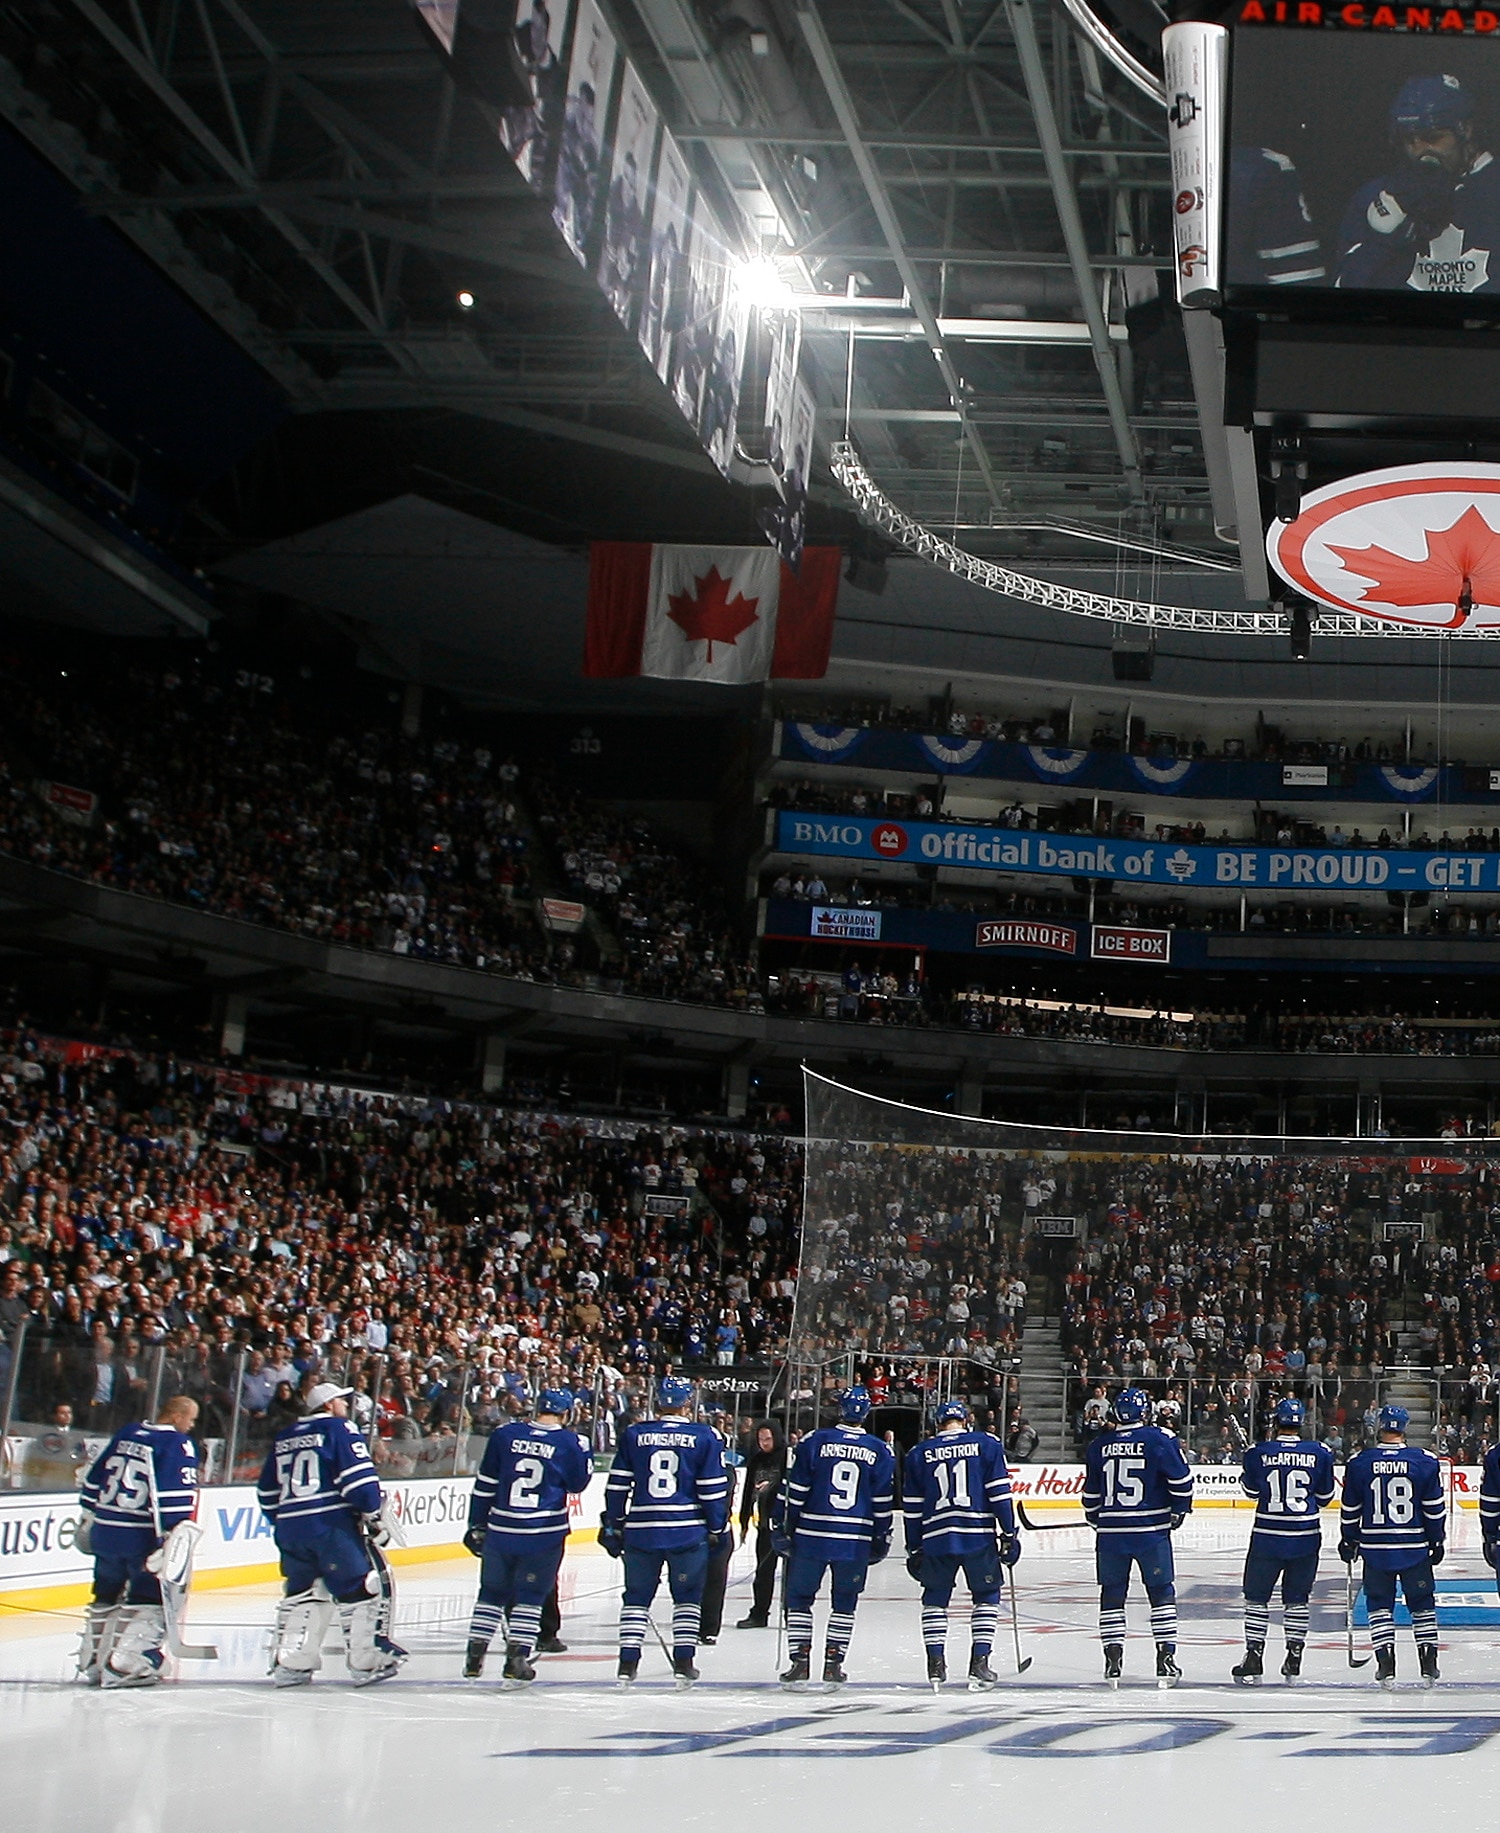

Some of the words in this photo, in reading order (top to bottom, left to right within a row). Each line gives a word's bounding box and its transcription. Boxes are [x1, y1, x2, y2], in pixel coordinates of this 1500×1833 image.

[1240, 0, 1321, 24] AIR
[1417, 260, 1476, 274] TORONTO
[1428, 272, 1466, 286] MAPLE
[793, 822, 863, 845] BMO
[920, 831, 1030, 867] Official
[1038, 838, 1116, 874] bank
[1123, 849, 1155, 876] of
[1215, 852, 1257, 883] BE
[1268, 853, 1389, 885] PROUD
[1425, 856, 1487, 887] GET
[831, 913, 876, 927] CANADIAN
[981, 924, 1071, 948] SMIRNOFF
[1099, 935, 1125, 951] ICE
[1129, 938, 1164, 955] BOX
[1039, 1220, 1070, 1233] IBM
[510, 1438, 557, 1461] SCHENN
[636, 1432, 697, 1450] KOMISAREK
[924, 1443, 979, 1463] SJOSTROM
[1101, 1442, 1144, 1458] KABERLE
[819, 1443, 877, 1466] ARMSTRONG
[1261, 1452, 1316, 1469] MacARTHUR
[276, 1449, 321, 1506] 50
[647, 1448, 680, 1499] 8
[1372, 1461, 1408, 1475] BROWN
[98, 1455, 151, 1511] 35
[508, 1456, 545, 1509] 2
[828, 1460, 861, 1510] 9
[933, 1458, 972, 1511] 11
[1101, 1458, 1146, 1507] 15
[1265, 1468, 1312, 1513] 16
[1369, 1476, 1415, 1524] 18
[216, 1506, 275, 1542] VIA
